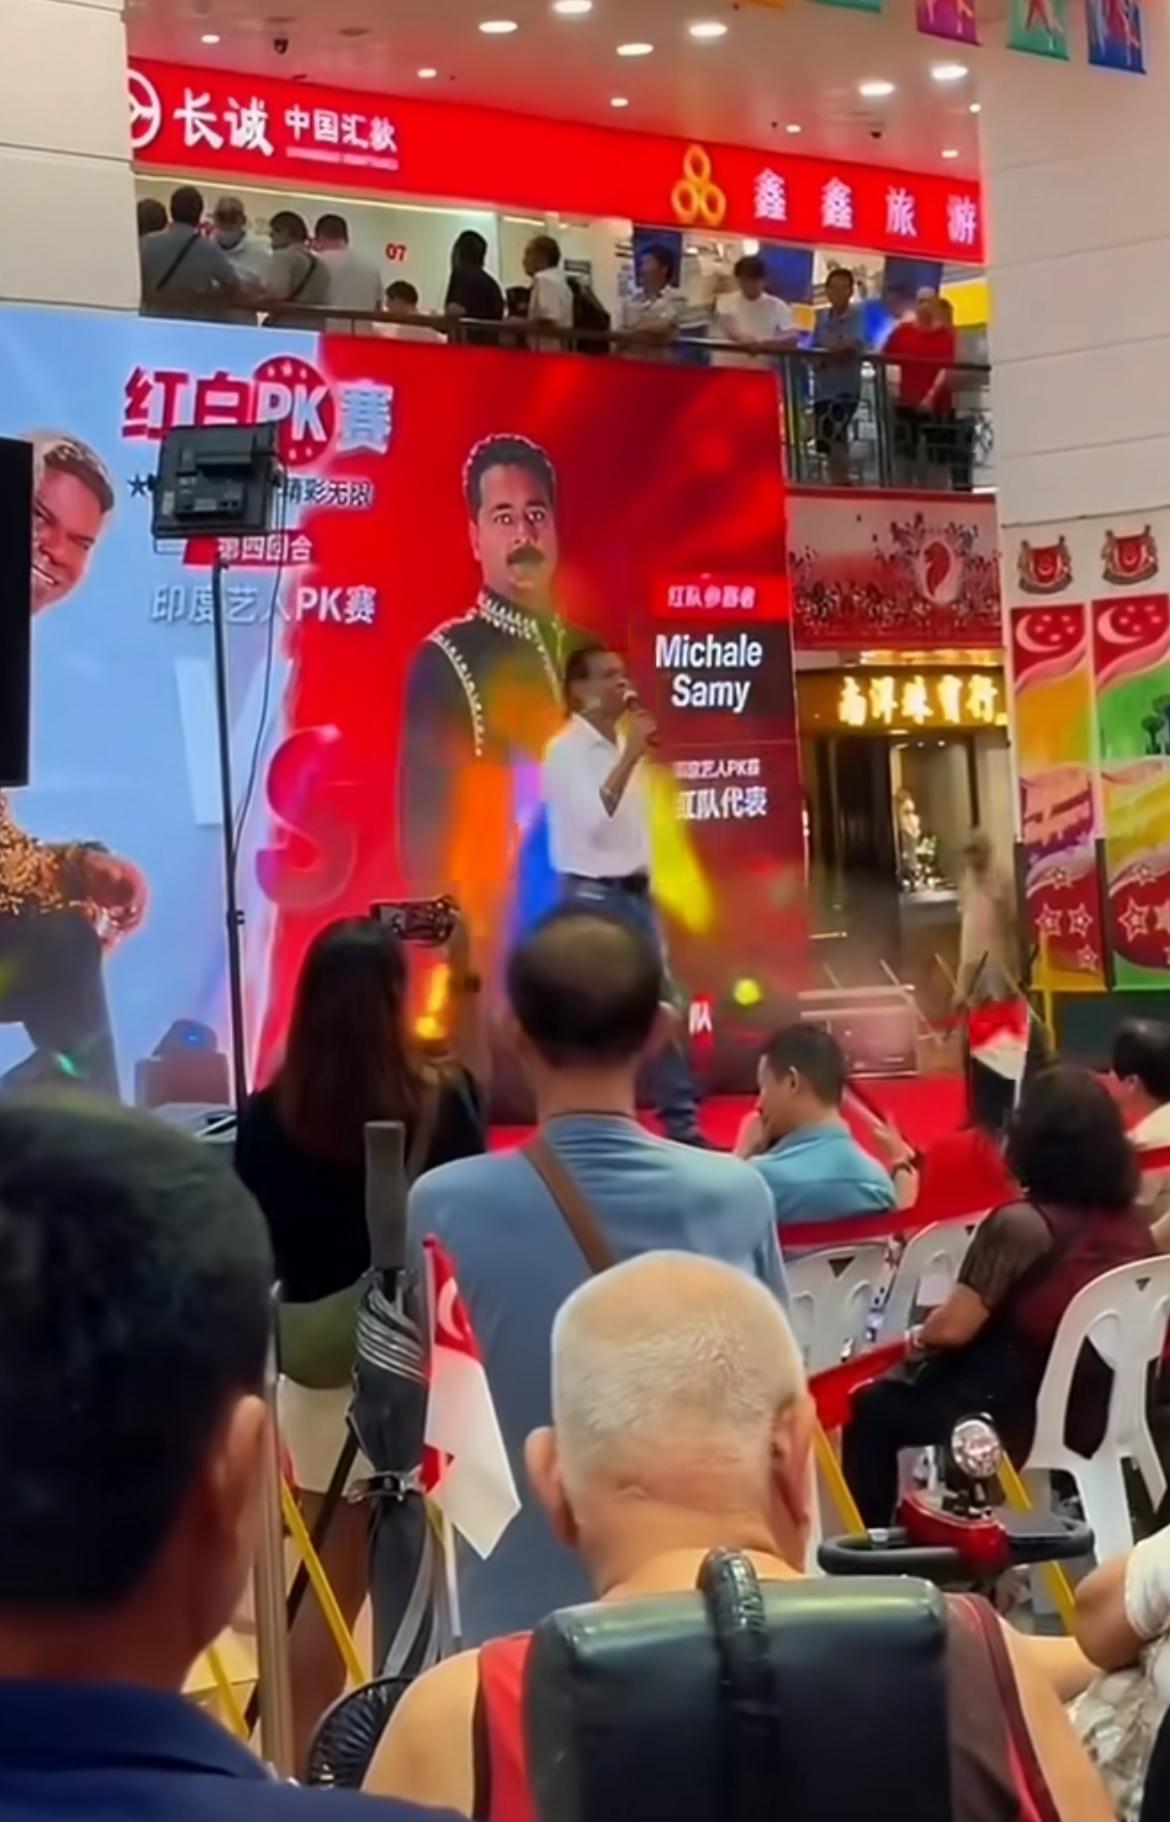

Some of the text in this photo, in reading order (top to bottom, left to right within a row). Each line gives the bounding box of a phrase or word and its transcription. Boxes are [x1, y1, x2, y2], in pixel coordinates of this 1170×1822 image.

[173, 88, 398, 157] 长诚 中国汇款
[752, 168, 979, 244] 鑫鑫旅游
[386, 243, 407, 262] 07
[122, 365, 394, 455] 红白PK赛
[150, 584, 377, 625] 印度艺人PK赛
[655, 633, 763, 669] Michale
[671, 673, 750, 713] Samy
